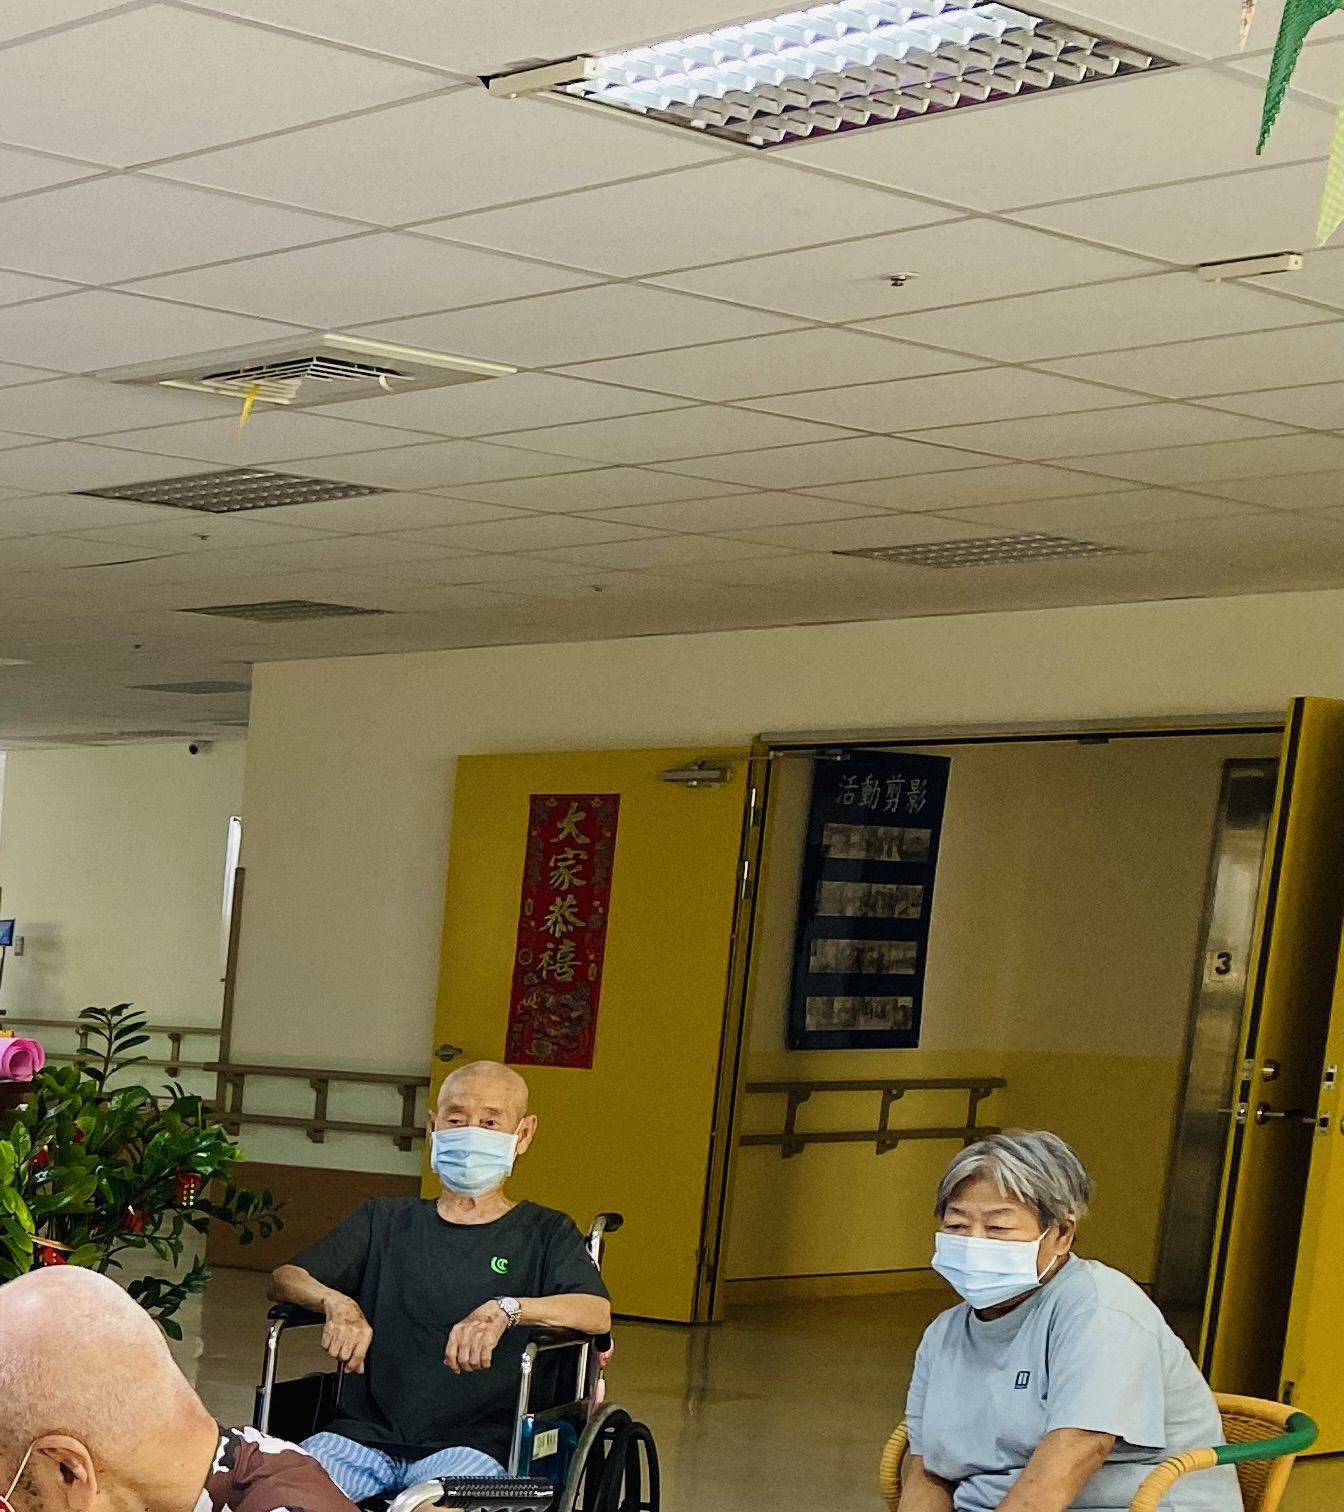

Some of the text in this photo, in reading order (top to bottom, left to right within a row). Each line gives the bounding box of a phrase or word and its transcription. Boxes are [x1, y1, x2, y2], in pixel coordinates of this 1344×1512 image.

[837, 774, 927, 813] 活動剪影
[537, 801, 591, 983] 大家恭禧
[1216, 952, 1232, 974] 3
